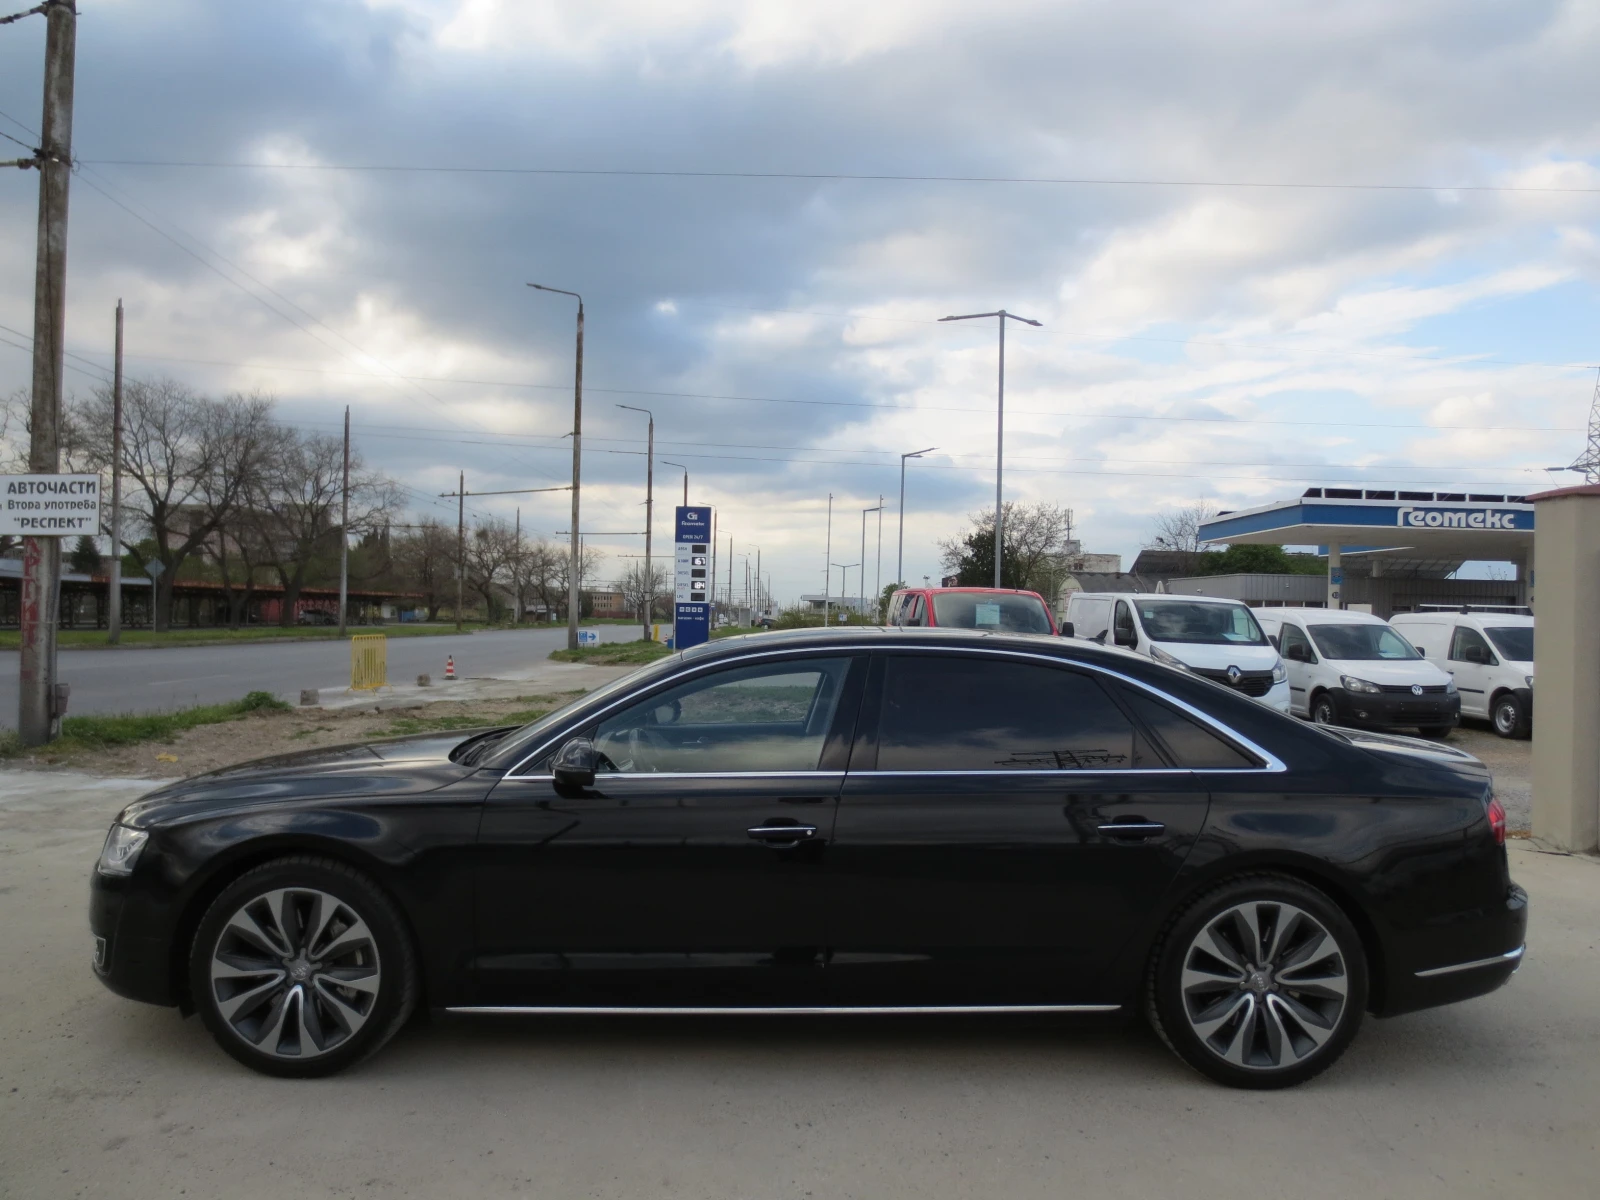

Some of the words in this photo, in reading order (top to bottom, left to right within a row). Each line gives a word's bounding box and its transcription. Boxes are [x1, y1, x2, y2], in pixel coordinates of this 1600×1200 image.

[7, 481, 96, 495] АВТОЧАСТИ
[8, 499, 41, 511] Втора
[44, 499, 97, 511] употреба
[13, 517, 92, 529] "РЕСПЕКТ"
